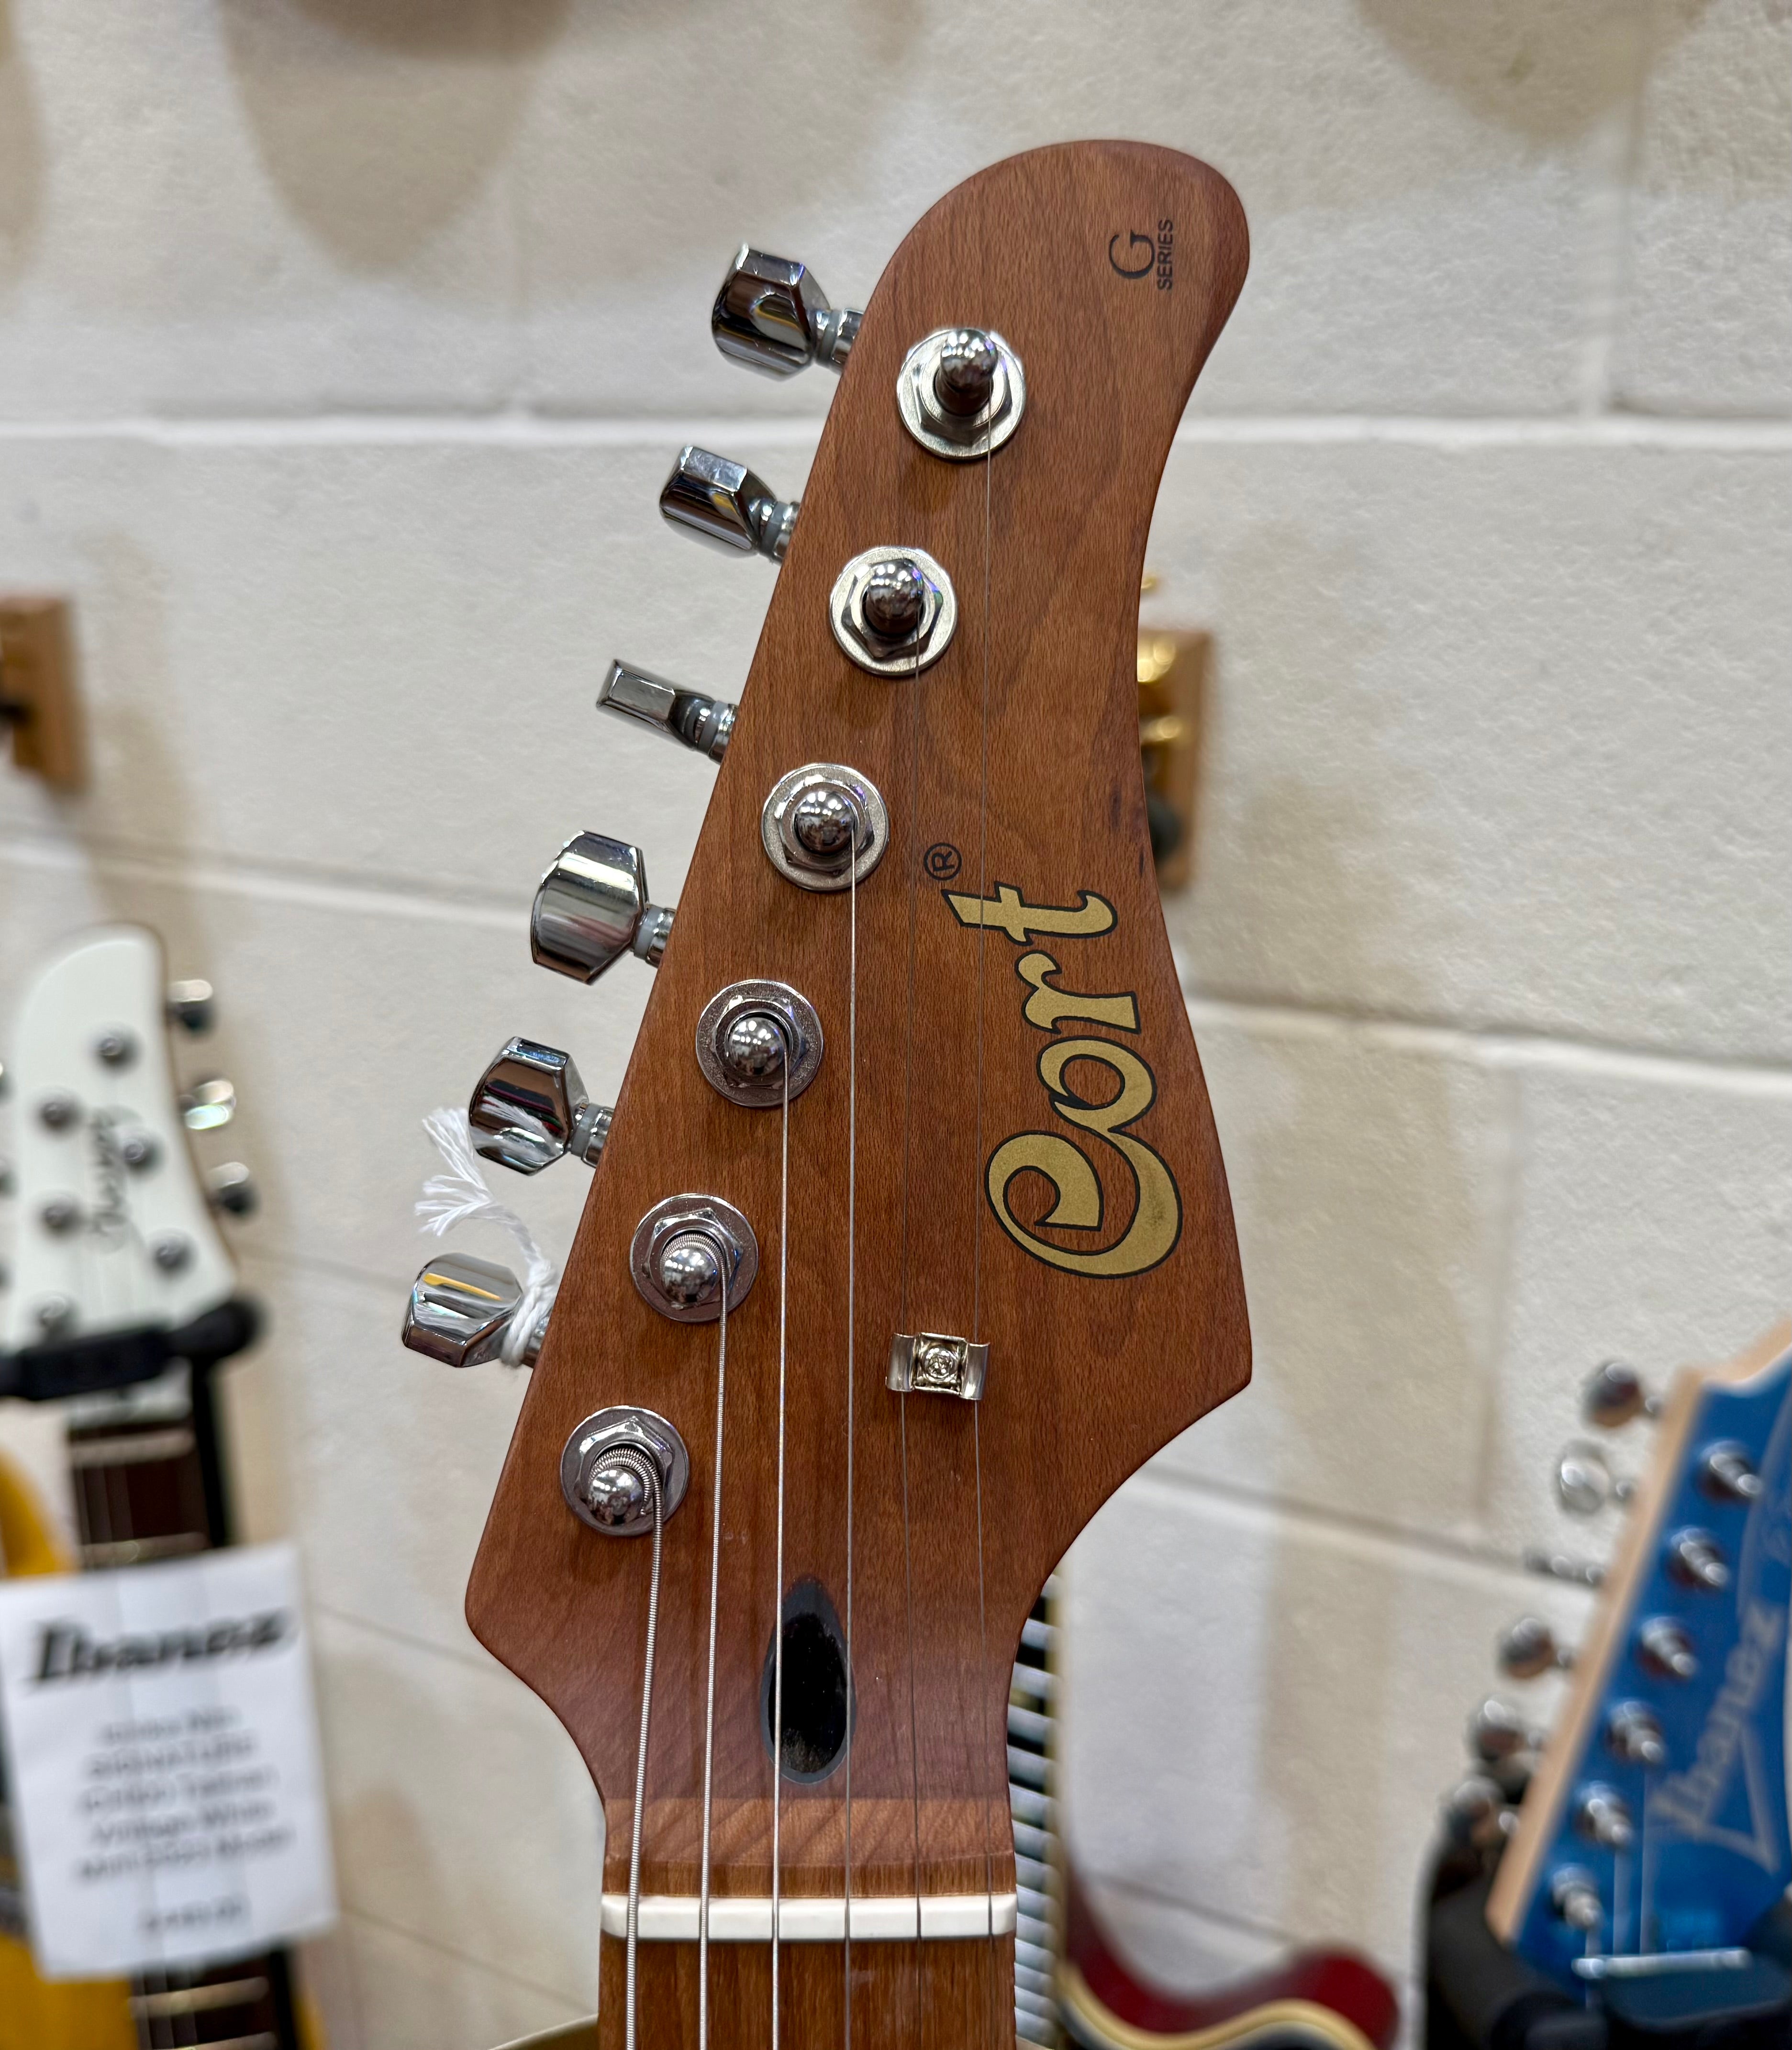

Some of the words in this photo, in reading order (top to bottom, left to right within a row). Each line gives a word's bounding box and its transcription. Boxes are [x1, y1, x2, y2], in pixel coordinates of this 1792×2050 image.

[1108, 229, 1155, 279] G
[1157, 219, 1173, 290] SERIES
[941, 881, 1182, 1280] Cort
[28, 1610, 292, 1687] Ibanez
